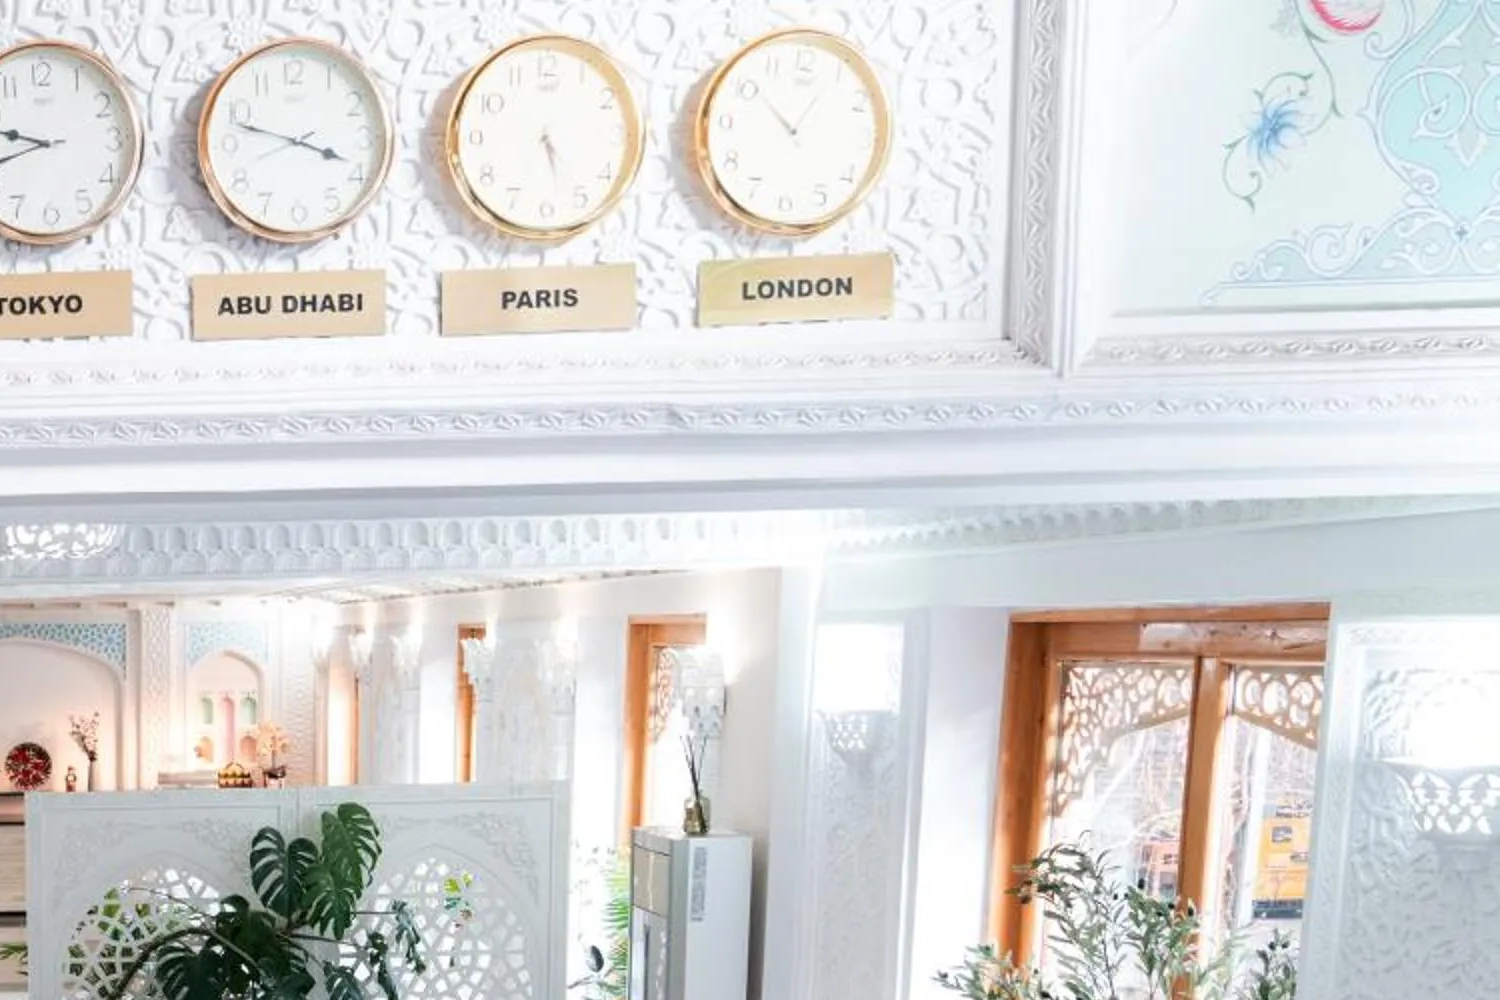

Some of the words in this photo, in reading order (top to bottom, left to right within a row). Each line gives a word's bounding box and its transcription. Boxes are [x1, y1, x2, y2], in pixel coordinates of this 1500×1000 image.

[2, 74, 17, 98] 11
[31, 61, 52, 87] 12
[72, 65, 79, 94] 1
[255, 71, 269, 98] 11
[284, 60, 303, 86] 12
[326, 64, 331, 91] 1
[94, 91, 112, 119] 2
[228, 98, 251, 126] 10
[345, 90, 363, 117] 2
[105, 126, 122, 152] 3
[357, 125, 373, 150] 3
[98, 163, 120, 184] 4
[231, 168, 249, 194] 8
[347, 163, 369, 185] 4
[8, 194, 27, 220] 7
[75, 188, 93, 215] 5
[257, 191, 273, 218] 7
[324, 186, 341, 213] 5
[43, 202, 61, 226] 6
[501, 287, 579, 310] PARIS
[742, 275, 853, 301] LONDON
[217, 294, 272, 316] ABU
[281, 292, 363, 314] DHABI
